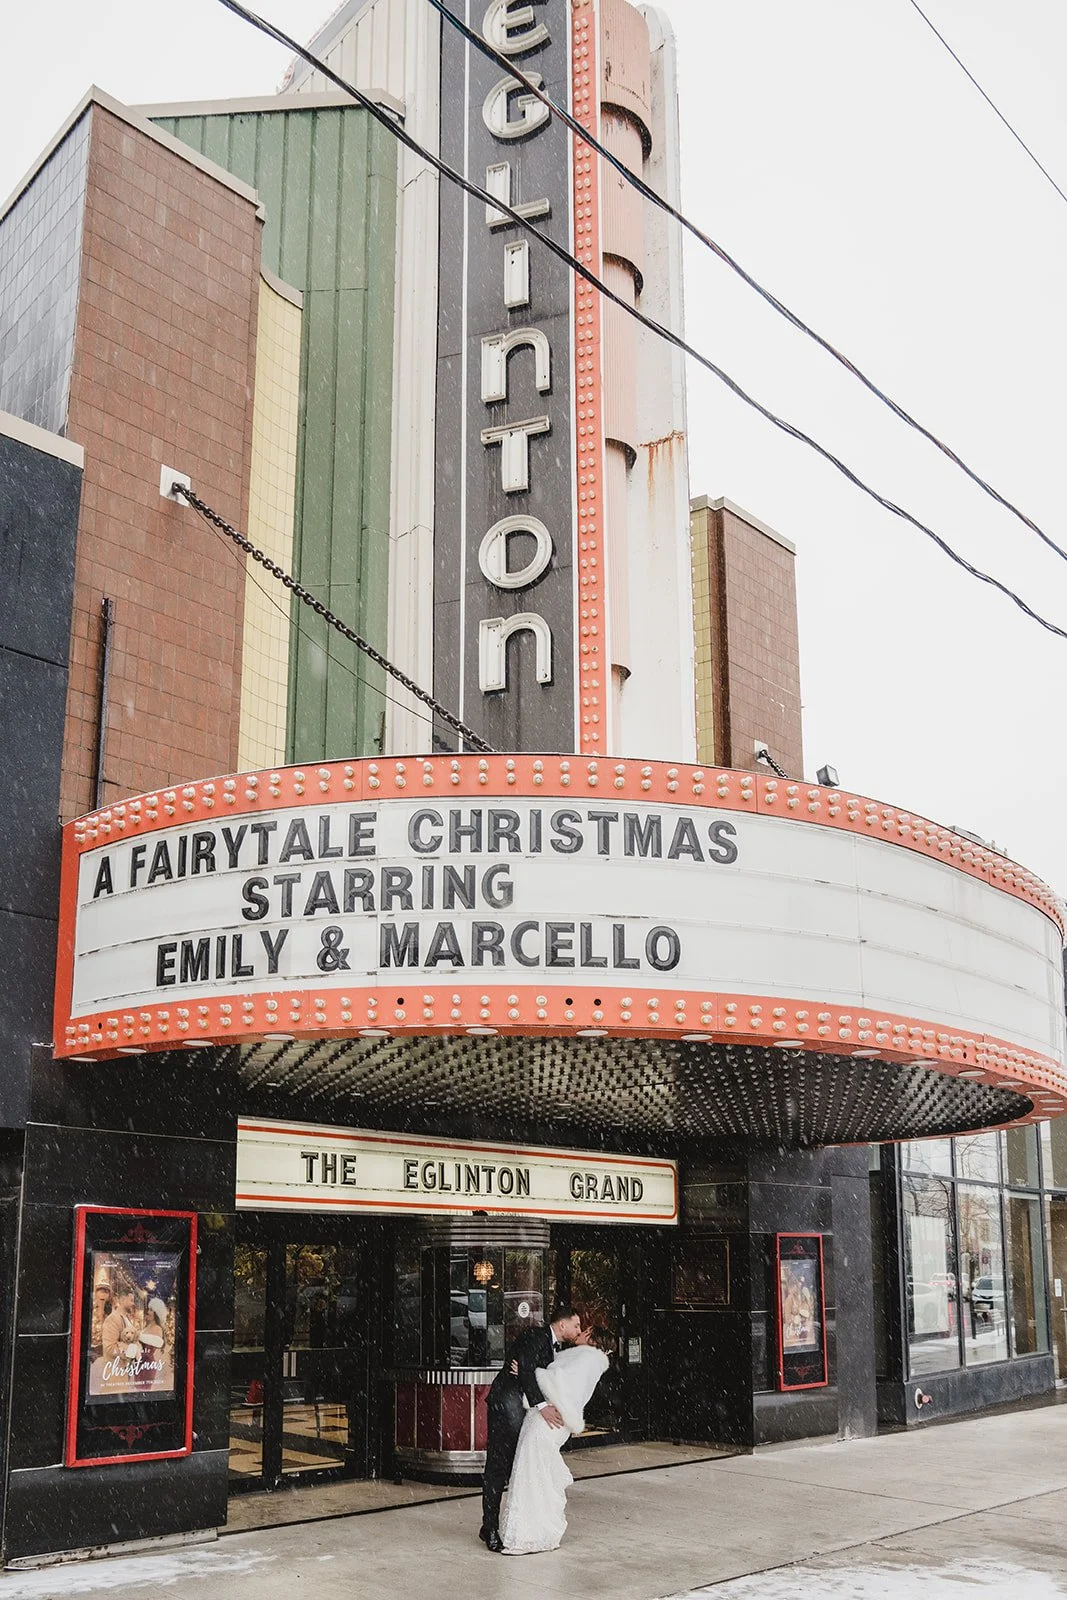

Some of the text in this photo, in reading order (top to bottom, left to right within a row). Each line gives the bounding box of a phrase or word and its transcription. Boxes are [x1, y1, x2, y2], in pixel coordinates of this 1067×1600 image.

[92, 808, 739, 898] A FAIRYTALE CHRISTMAS
[241, 863, 514, 921] STARRING
[156, 920, 682, 987] EMILY & MARCELLO
[300, 1151, 644, 1203] THE EGLINTON GRAND
[102, 1355, 165, 1381] Christmas
